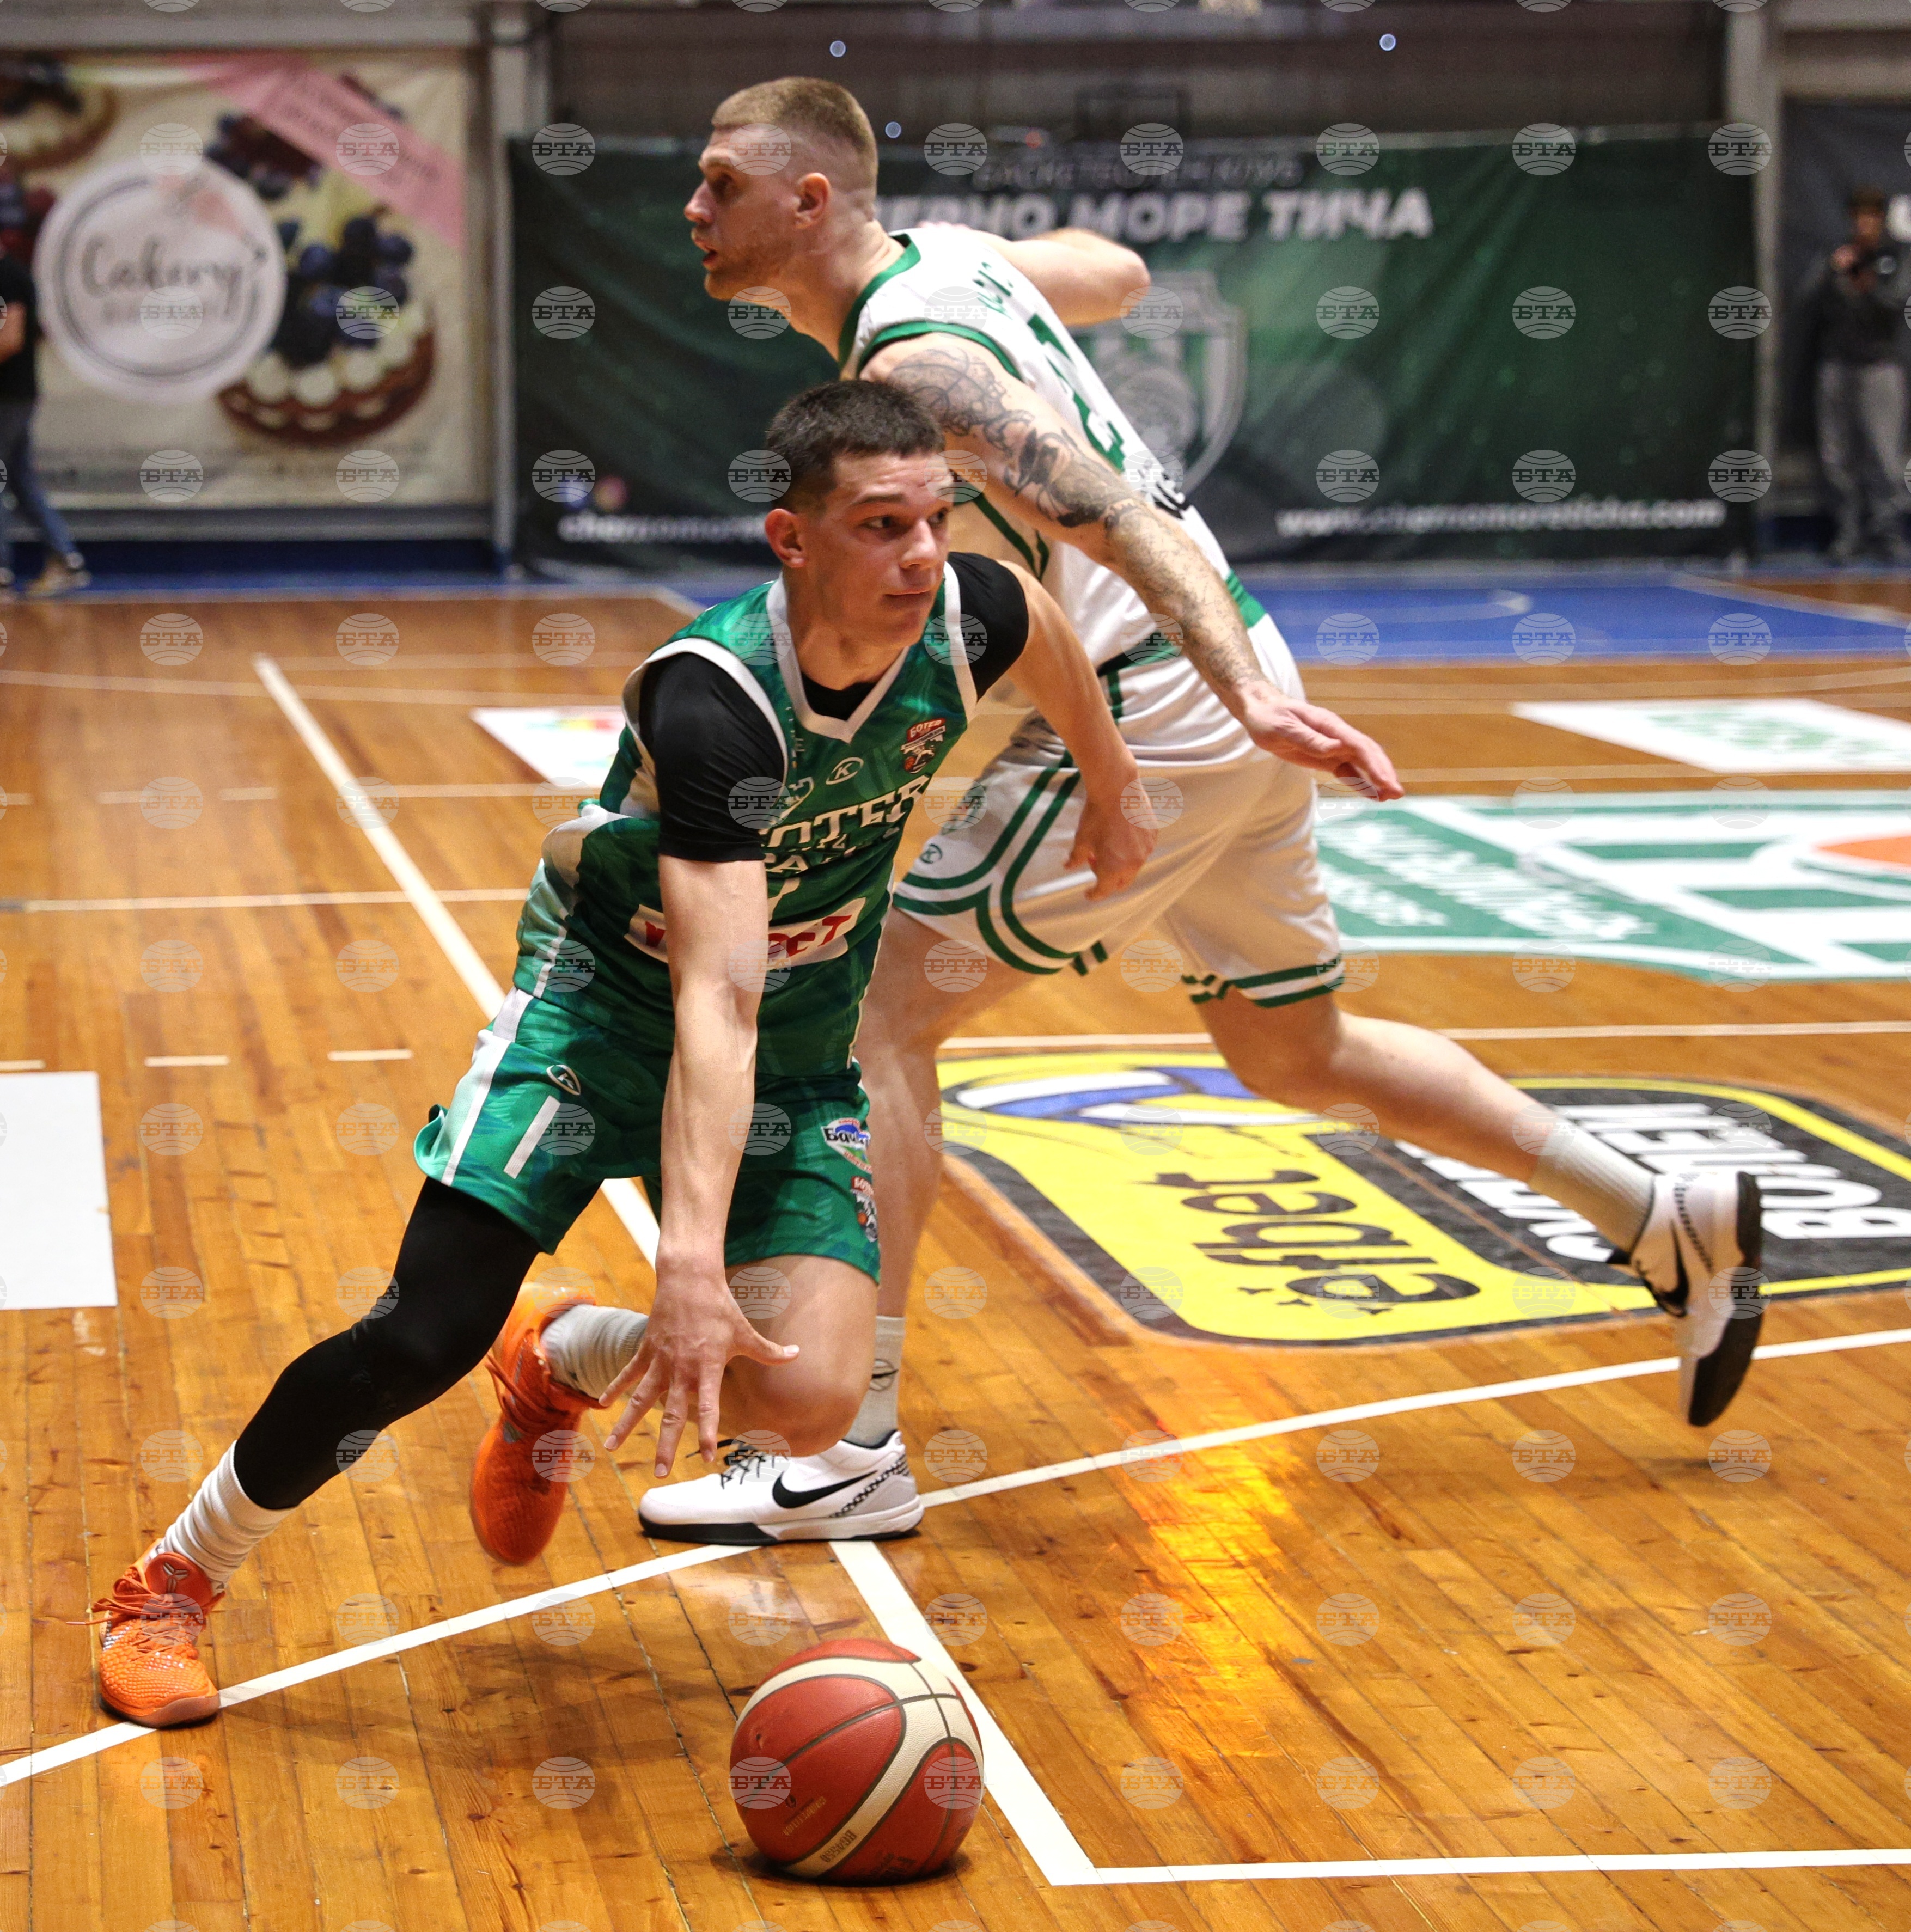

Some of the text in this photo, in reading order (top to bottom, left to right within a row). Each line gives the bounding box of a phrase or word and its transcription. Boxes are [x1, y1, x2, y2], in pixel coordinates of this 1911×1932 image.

[1071, 191, 1253, 242] МОРЕ
[1262, 187, 1434, 240] ТИЧА
[1144, 1169, 1480, 1303] efbet
